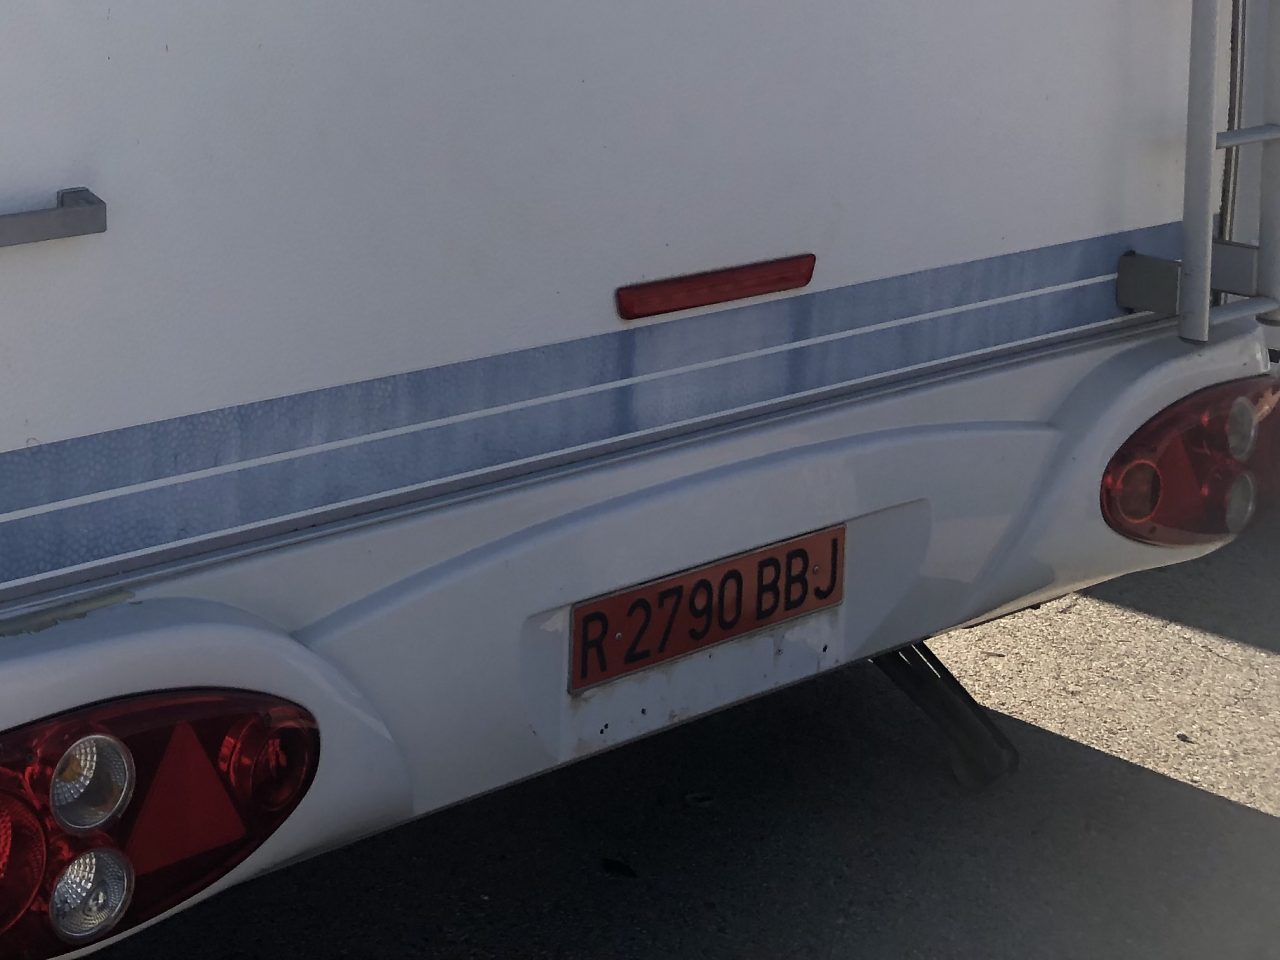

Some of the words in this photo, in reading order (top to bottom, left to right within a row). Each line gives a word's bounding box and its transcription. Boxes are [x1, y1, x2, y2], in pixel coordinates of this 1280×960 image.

[580, 611, 609, 679] R
[624, 569, 744, 665] 2790
[756, 537, 839, 622] BBJ
